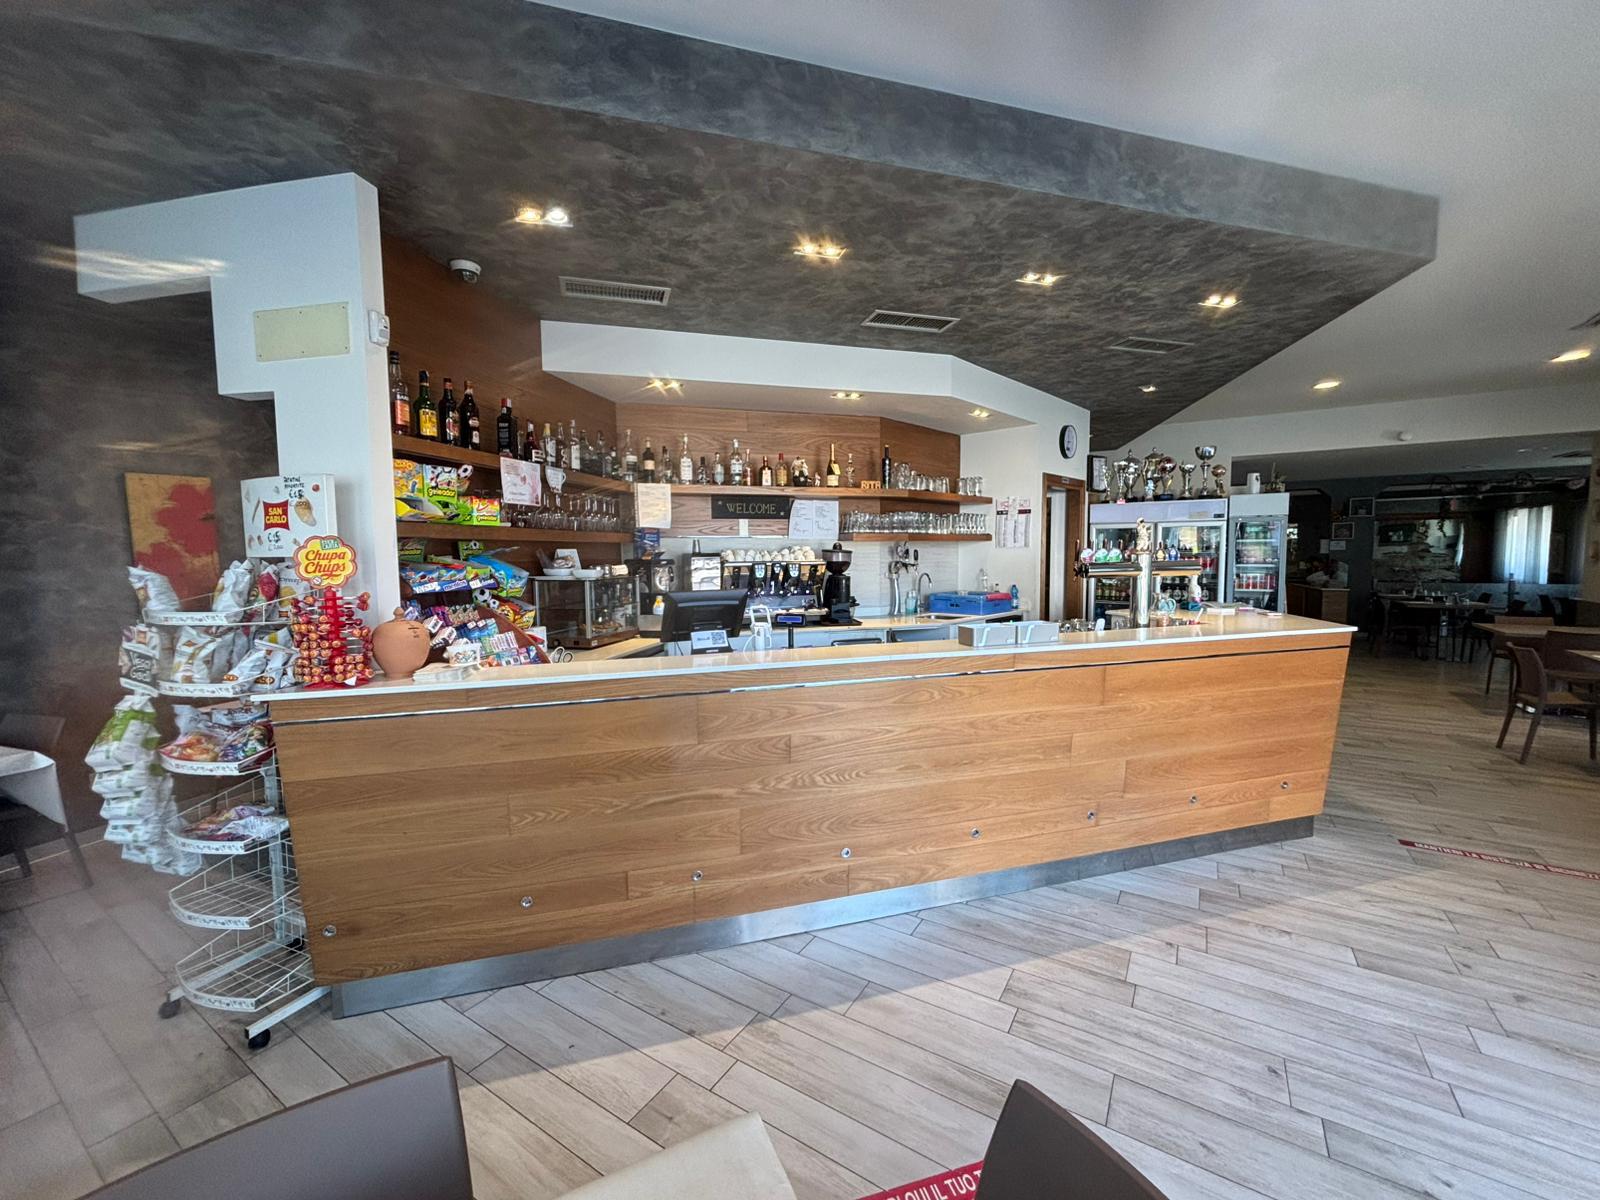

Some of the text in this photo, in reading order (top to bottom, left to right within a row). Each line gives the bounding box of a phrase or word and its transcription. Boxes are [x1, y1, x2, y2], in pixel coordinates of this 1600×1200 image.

[268, 507, 282, 515] SAN
[726, 502, 777, 515] WELCOME
[265, 514, 287, 524] CARLO
[305, 550, 346, 563] Chupa
[304, 561, 346, 579] Chups
[944, 1174, 975, 1195] TUO
